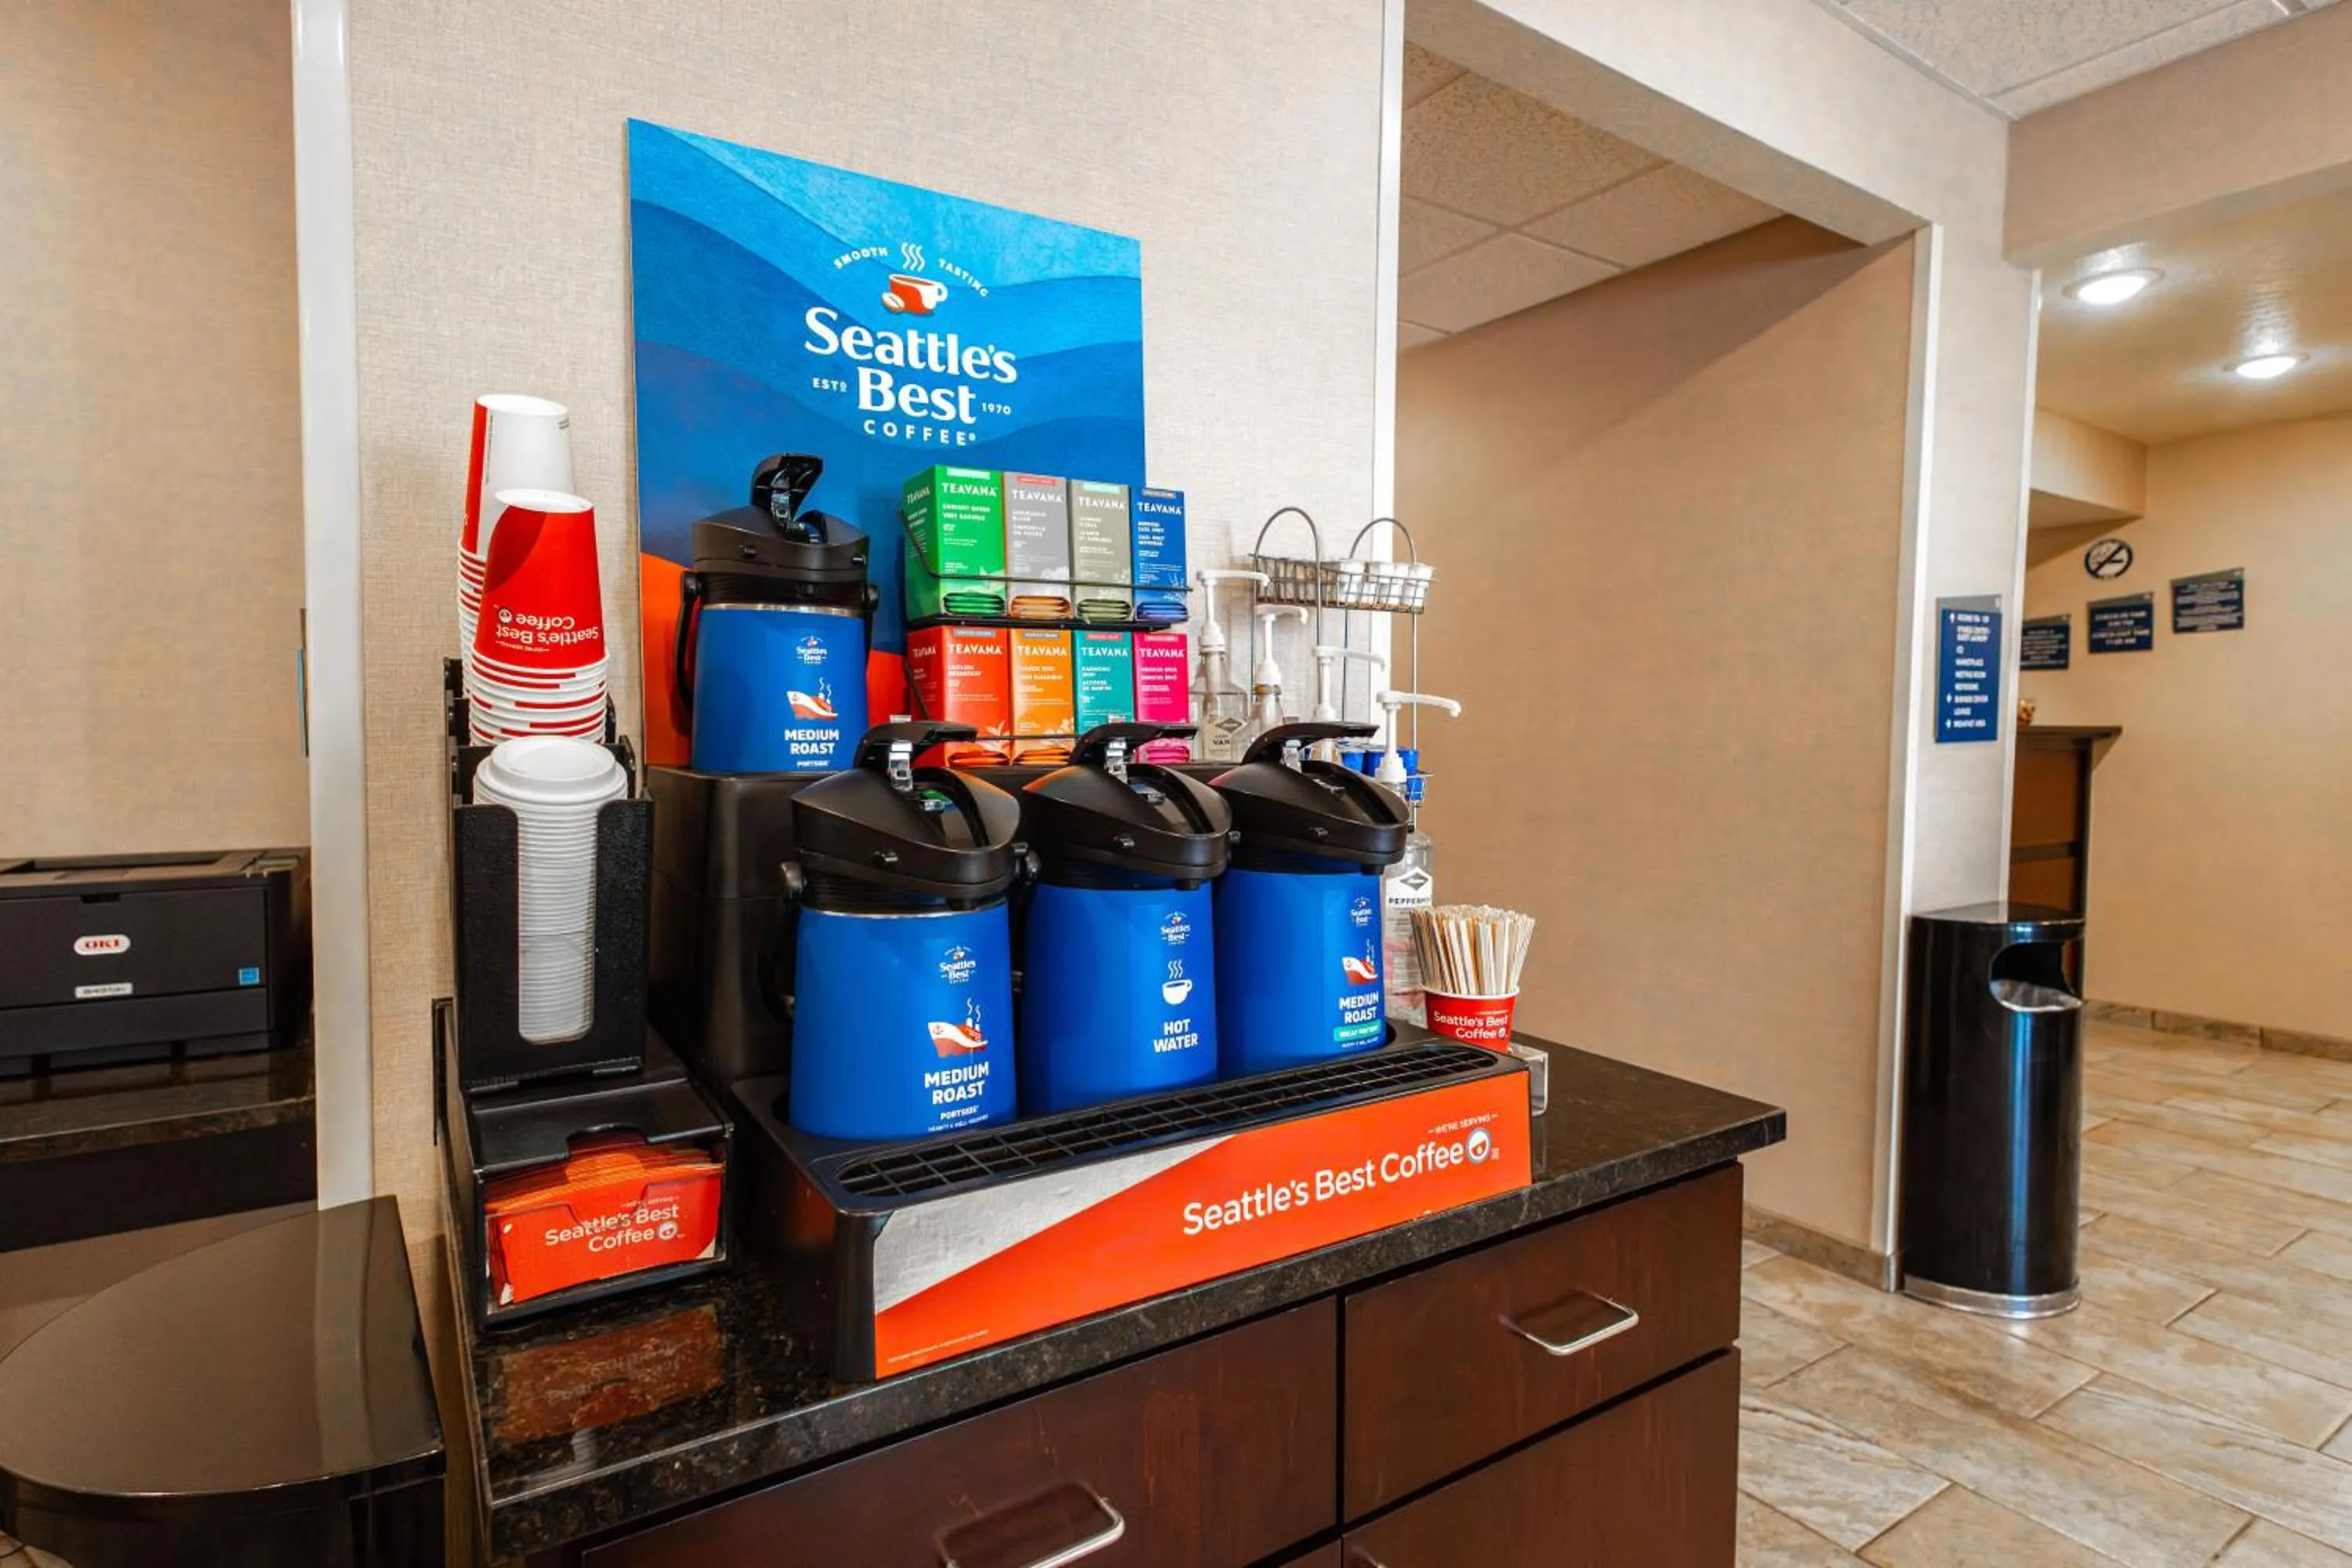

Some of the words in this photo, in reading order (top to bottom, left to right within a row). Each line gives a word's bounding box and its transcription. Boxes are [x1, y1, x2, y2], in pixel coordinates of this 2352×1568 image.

[833, 246, 888, 270] SMOOTH
[938, 259, 989, 297] TASTING
[804, 307, 1018, 383] Seattle's
[857, 366, 977, 424] Best
[982, 402, 1011, 415] 1970
[941, 482, 997, 498] TEAVANA
[1011, 488, 1063, 503] TEAVANA
[1079, 496, 1126, 511] TEAVANA
[1136, 502, 1181, 515] TEAVANA
[516, 614, 575, 630] Coffee
[495, 624, 533, 644] Best
[538, 626, 598, 646] Seattle's
[947, 644, 1003, 655] TEAVANA
[1016, 645, 1067, 656] TEAVANA
[1081, 647, 1128, 657] TEAVANA
[1139, 648, 1185, 659] TEAVANA
[784, 729, 840, 741] MEDIUM
[790, 742, 835, 754] ROAST
[85, 938, 120, 949] OKI
[1339, 991, 1379, 1010] MEDIUM
[1345, 1007, 1377, 1024] ROAST
[1433, 1011, 1484, 1028] Seattle's
[1486, 1015, 1508, 1027] Best
[1163, 1018, 1191, 1036] HOT
[1455, 1028, 1497, 1039] Coffee
[1153, 1033, 1198, 1053] WATER
[924, 1061, 989, 1088] MEDIUM
[932, 1081, 985, 1105] ROAST
[1182, 1180, 1309, 1236] Seattle's
[1315, 1162, 1376, 1201] Best
[1380, 1141, 1464, 1182] Coffee
[545, 1213, 633, 1246] Seattle's
[635, 1204, 679, 1224] Best
[589, 1228, 654, 1252] Coffee
